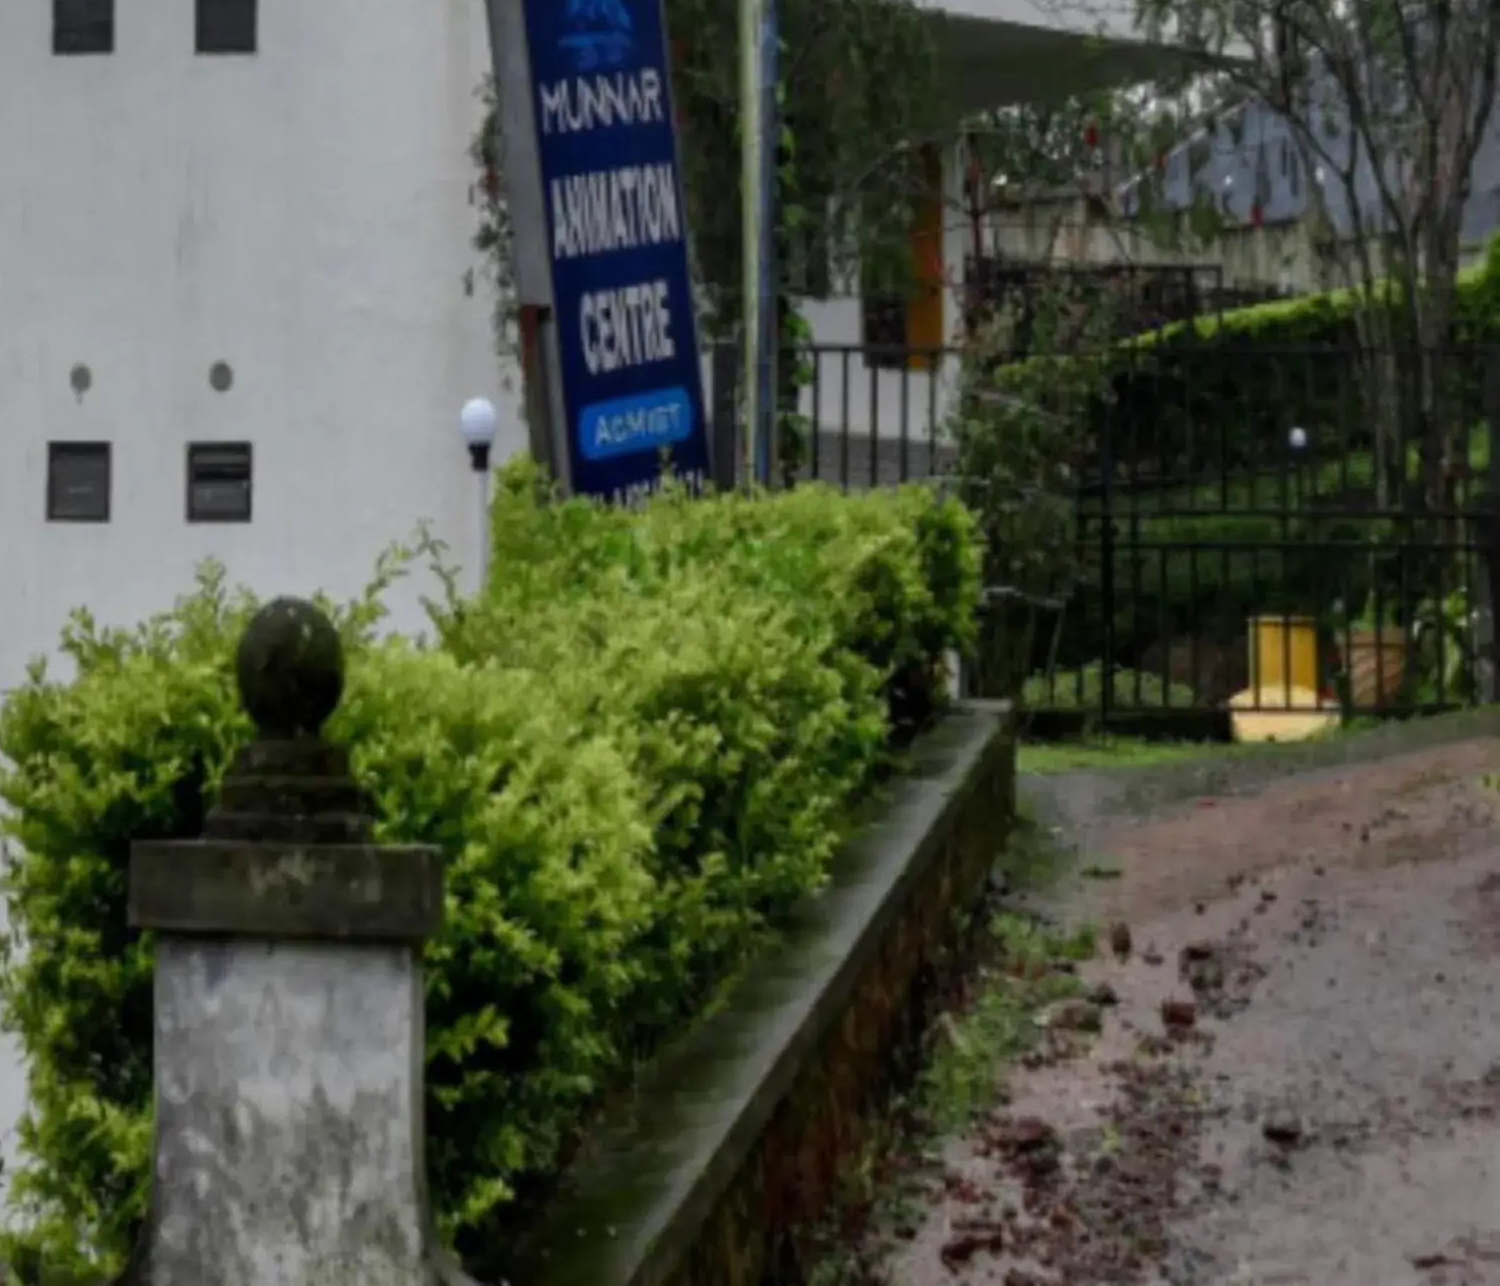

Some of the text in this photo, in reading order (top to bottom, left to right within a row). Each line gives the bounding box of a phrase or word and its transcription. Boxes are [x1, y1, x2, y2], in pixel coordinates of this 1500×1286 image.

[540, 68, 663, 135] MUNNAR
[551, 162, 679, 259] ANIMATION
[580, 280, 675, 374] CENTRE
